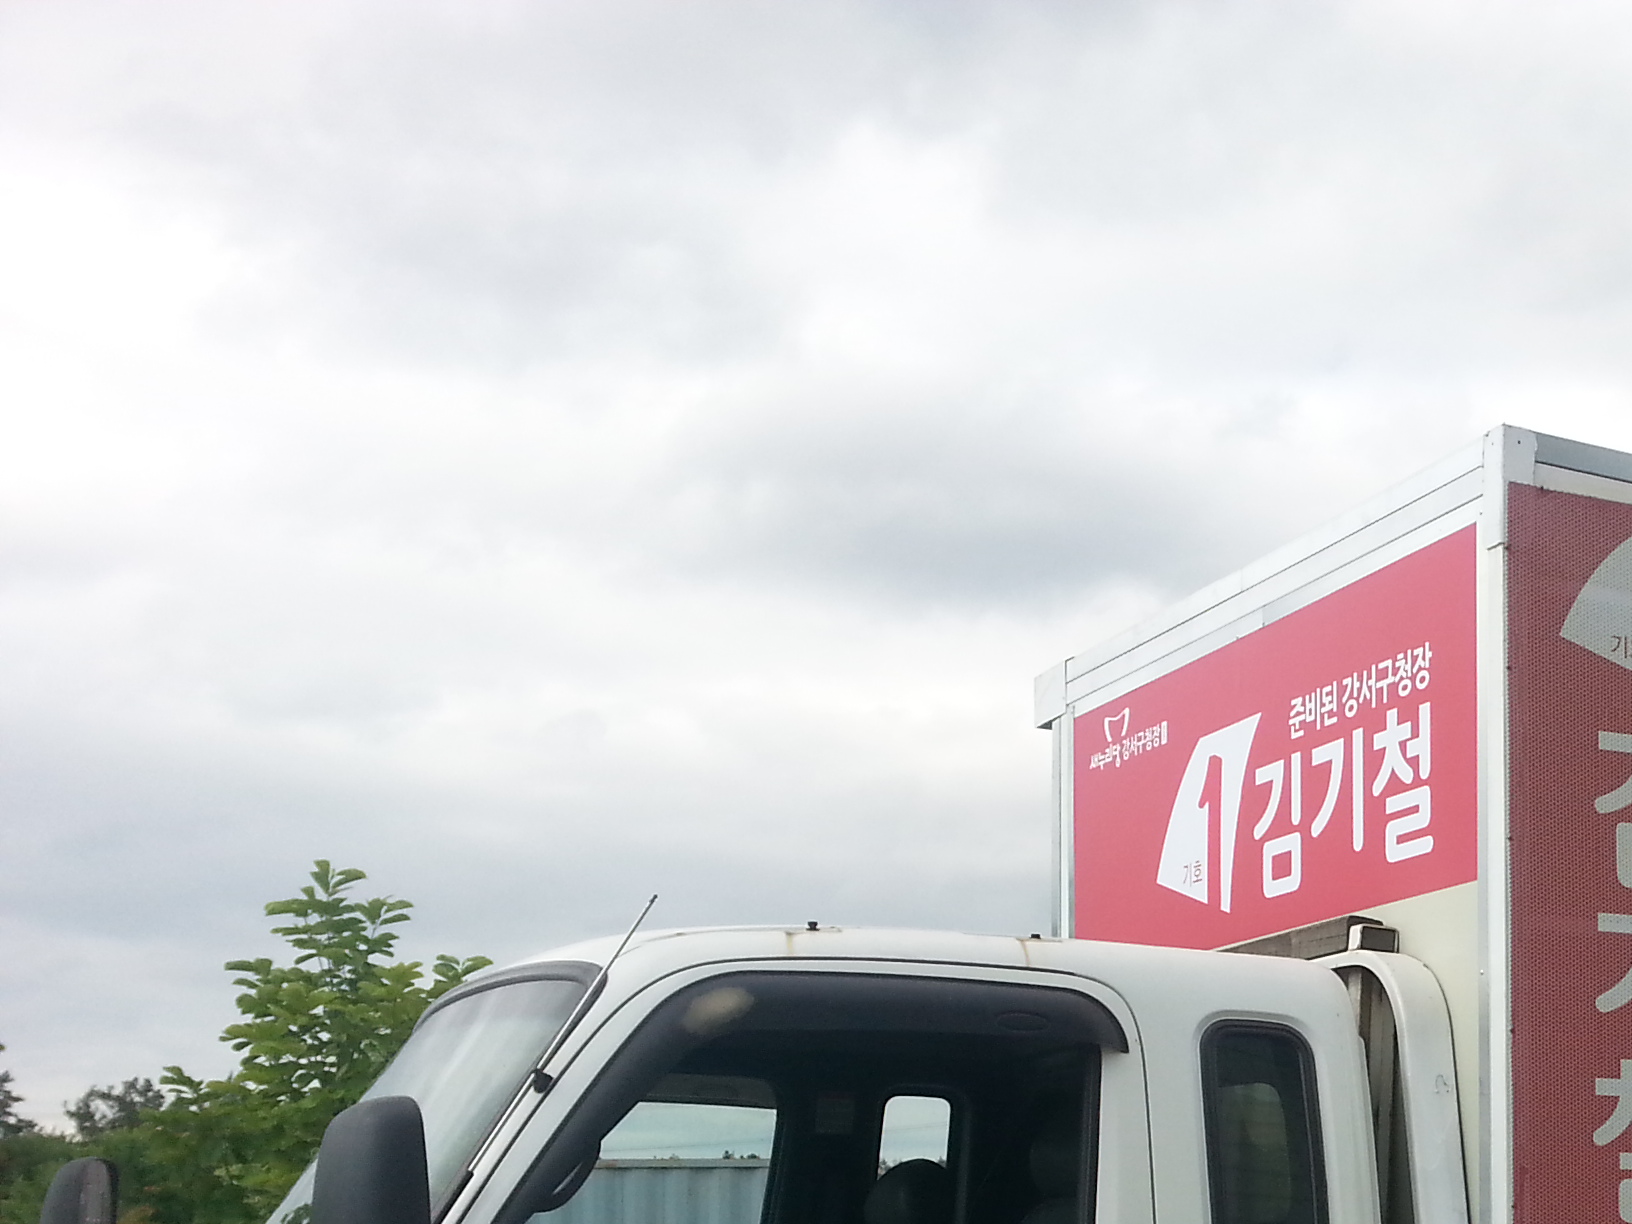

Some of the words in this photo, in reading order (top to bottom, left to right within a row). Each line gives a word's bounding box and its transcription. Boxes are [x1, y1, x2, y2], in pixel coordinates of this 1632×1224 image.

[1288, 688, 1339, 740] 준비된
[1341, 642, 1433, 719] 강서구청장
[1122, 723, 1160, 760] 강서구청장
[1253, 701, 1434, 899] 김기철
[1182, 860, 1204, 888] 기호
